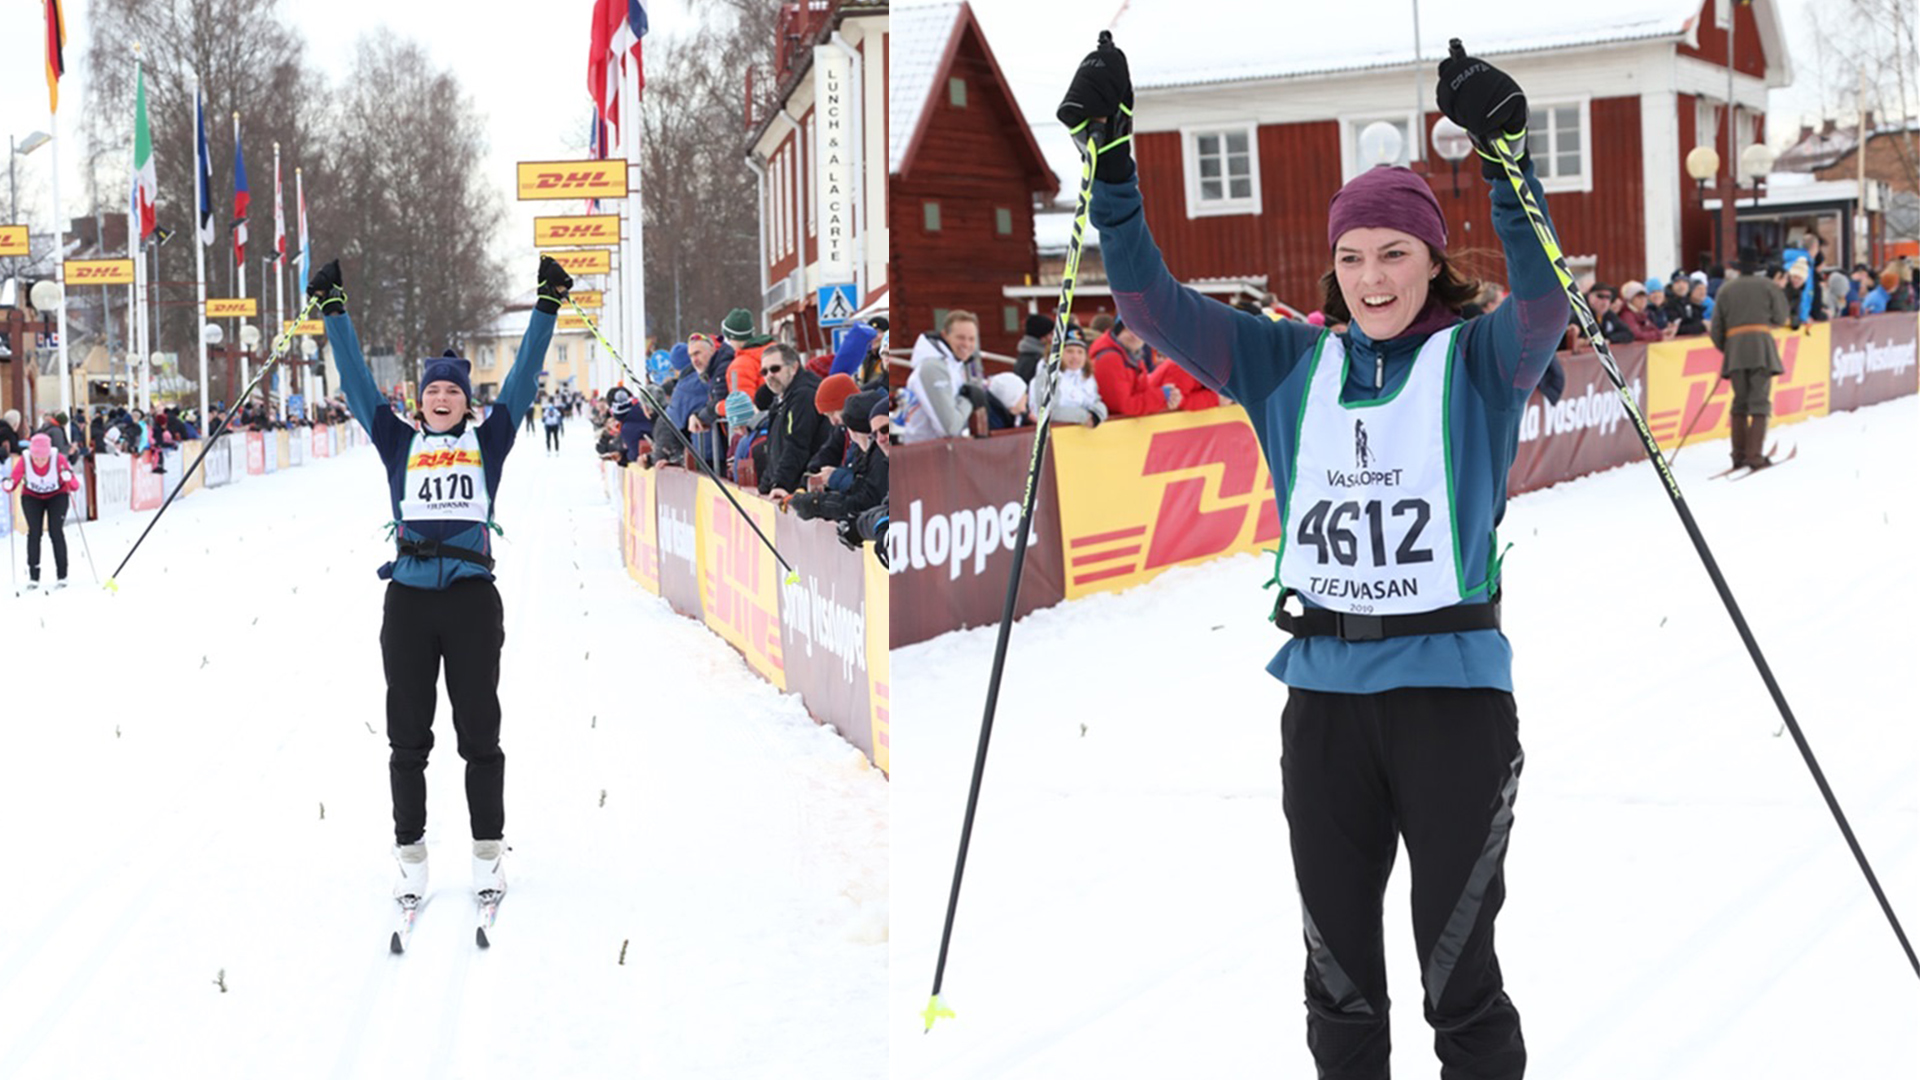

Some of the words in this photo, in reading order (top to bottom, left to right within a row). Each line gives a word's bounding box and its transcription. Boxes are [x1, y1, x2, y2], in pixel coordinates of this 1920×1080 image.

[1450, 63, 1482, 91] CRAFT
[827, 69, 840, 130] LUNCH
[828, 137, 839, 148] &
[828, 154, 840, 165] A
[535, 171, 611, 189] DHL
[0, 233, 16, 247] L
[549, 224, 607, 238] DHL
[829, 201, 841, 262] CARTE
[75, 266, 123, 278] DHL
[213, 303, 248, 312] DHL
[1679, 336, 1806, 438] DL
[1543, 378, 1642, 437] Vasaloppt
[417, 450, 472, 468] DHL
[418, 473, 474, 502] 4170
[1142, 420, 1282, 572] D
[1297, 497, 1434, 567] 4612
[1309, 576, 1419, 600] TJEJVASAN
[1349, 603, 1375, 614] 2019
